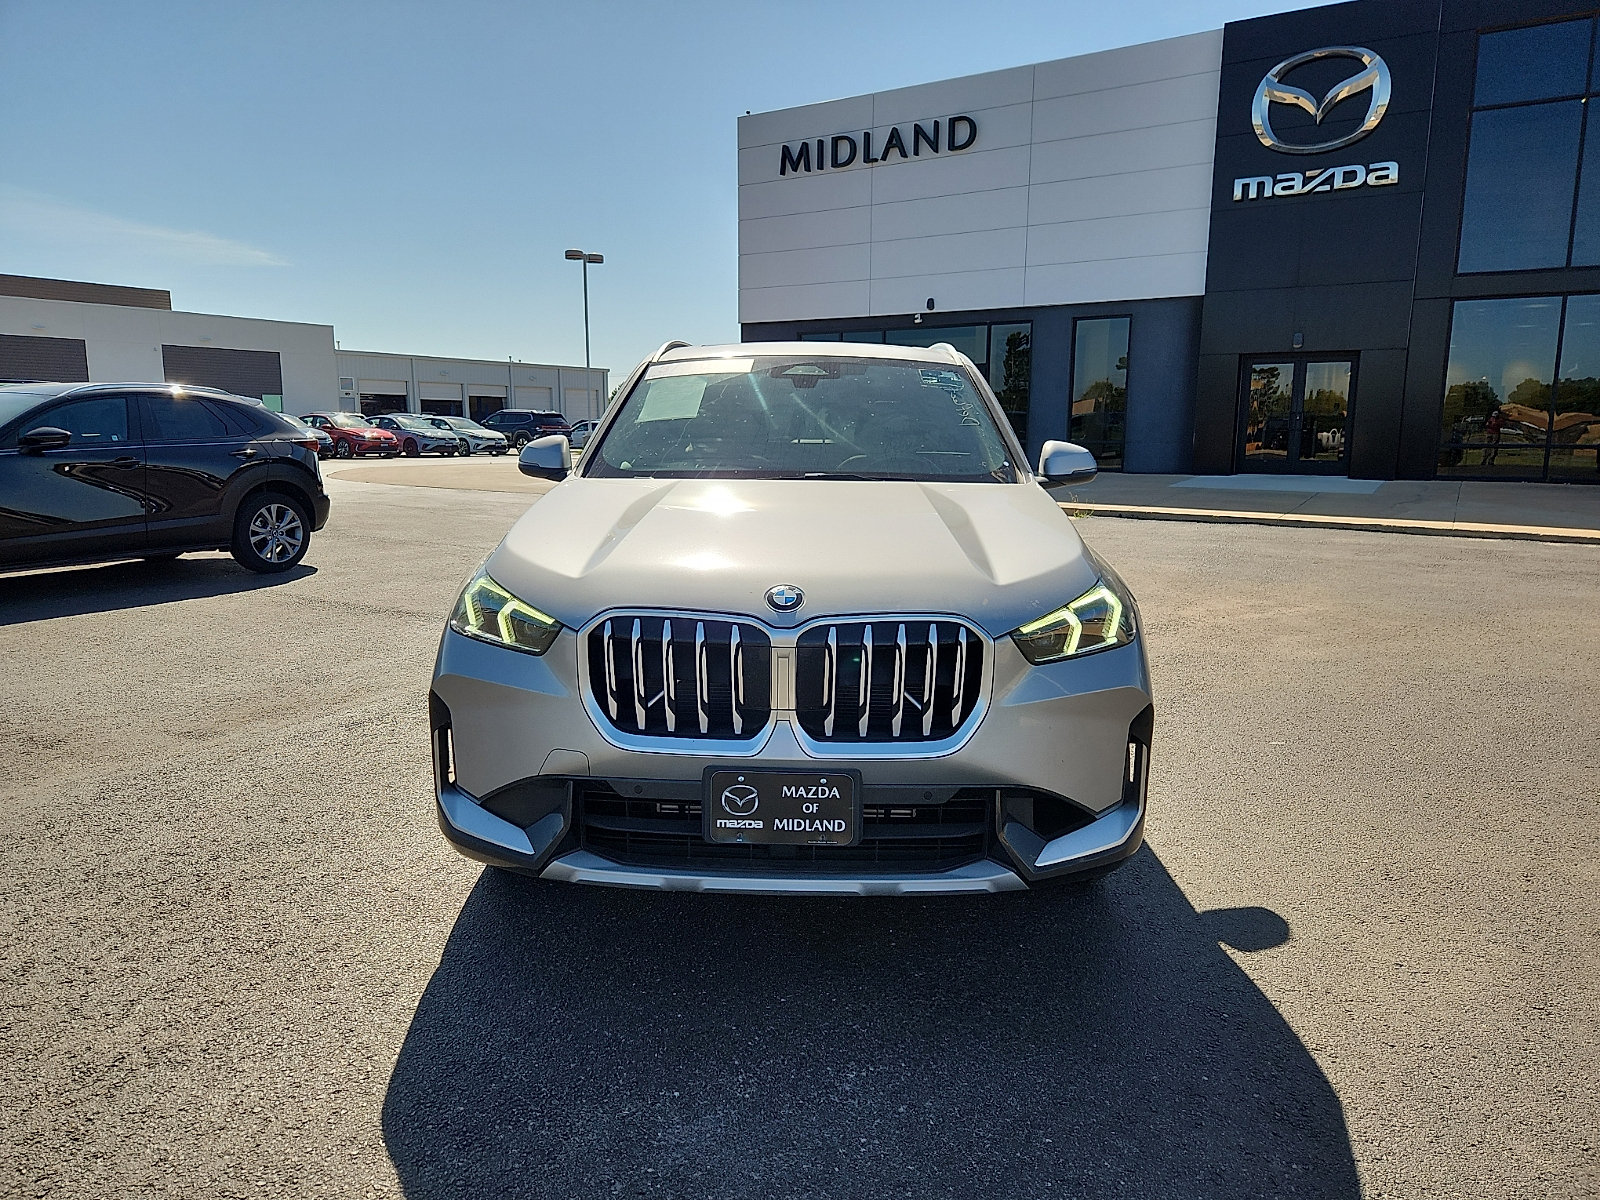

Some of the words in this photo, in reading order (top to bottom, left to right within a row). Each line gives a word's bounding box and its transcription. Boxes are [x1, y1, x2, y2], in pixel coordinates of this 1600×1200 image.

[780, 115, 978, 176] MIDLAND
[1233, 161, 1399, 201] mazda
[782, 786, 840, 799] MAZDA
[802, 803, 820, 814] OF
[716, 819, 764, 829] mazda
[774, 819, 846, 832] MIDLAND
